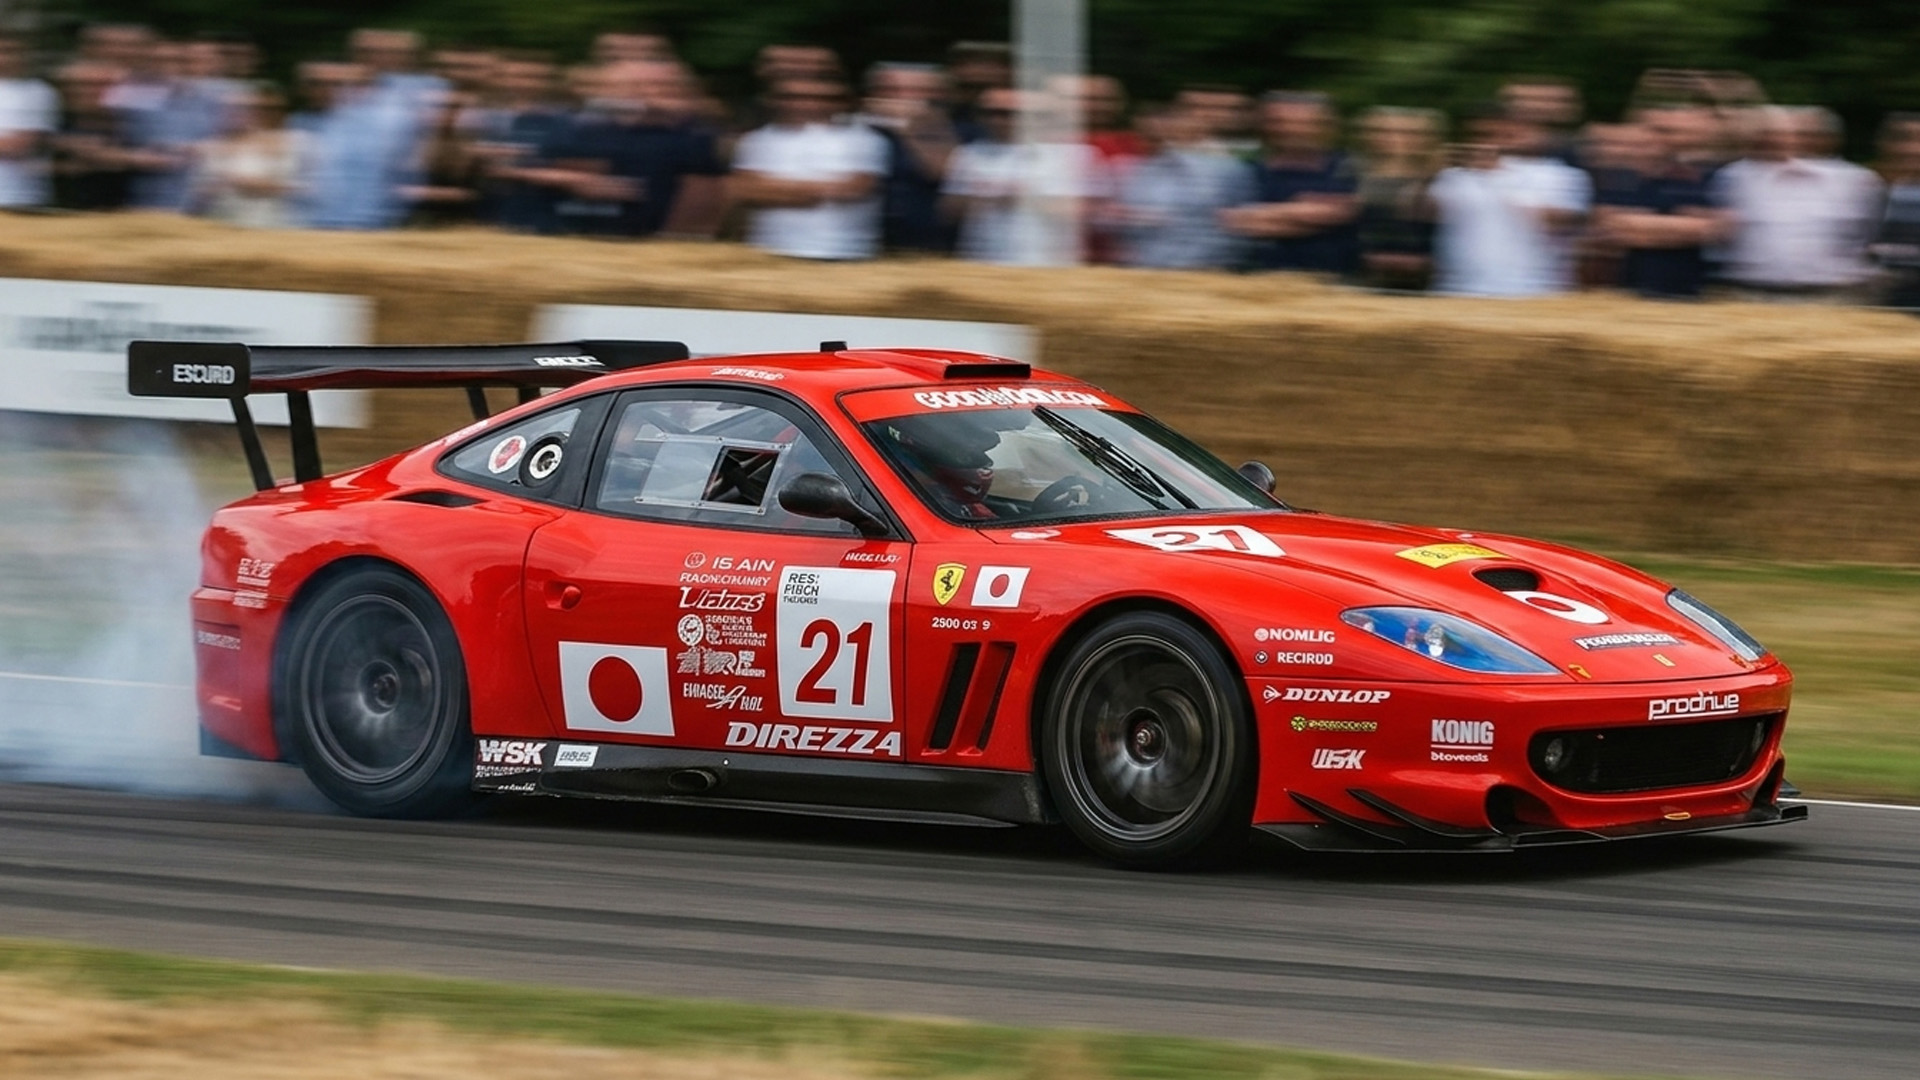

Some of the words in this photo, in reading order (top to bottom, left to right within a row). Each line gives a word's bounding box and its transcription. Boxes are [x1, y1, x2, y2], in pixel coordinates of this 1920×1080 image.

[1152, 530, 1250, 551] 21
[795, 617, 874, 706] 21
[1282, 688, 1391, 704] DUNLOP
[725, 721, 901, 757] DIREZZA
[1431, 719, 1495, 745] KONIG
[479, 739, 547, 765] WSK
